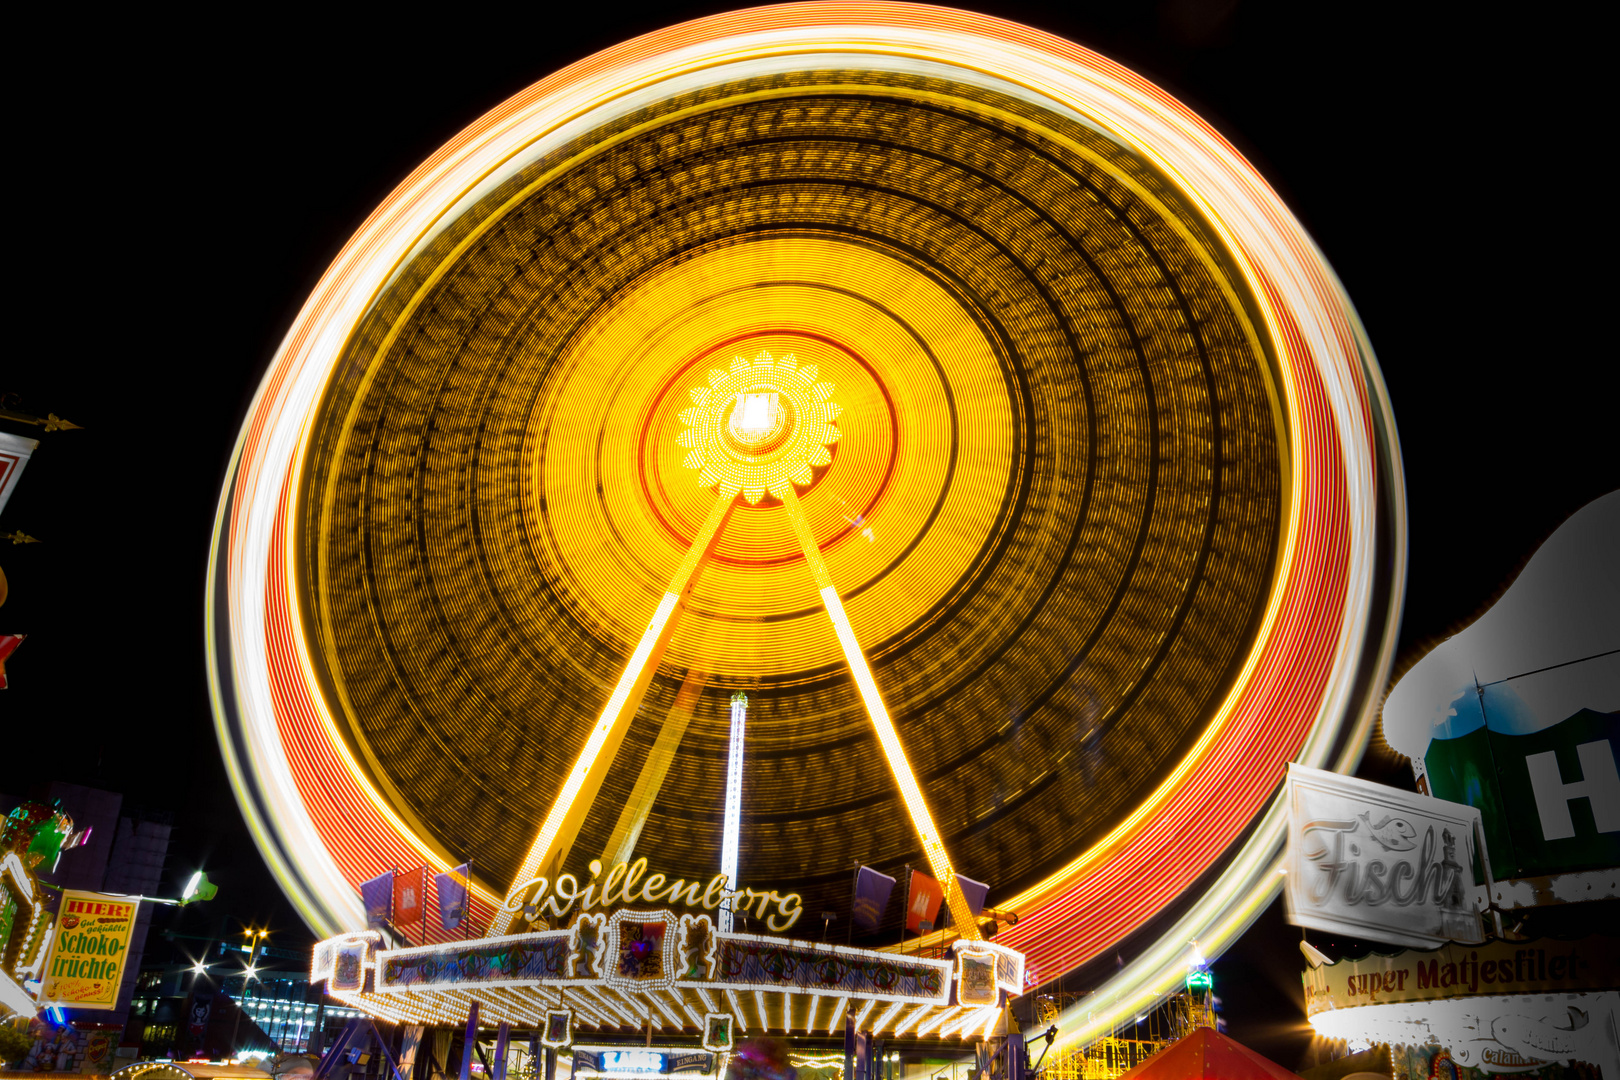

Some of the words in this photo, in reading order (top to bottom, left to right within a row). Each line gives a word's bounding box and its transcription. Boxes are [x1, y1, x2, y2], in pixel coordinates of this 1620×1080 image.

[1301, 817, 1454, 907] Fisch
[503, 857, 803, 932] Willenborg
[67, 901, 131, 917] HIER!
[86, 924, 126, 934] gekühlte
[58, 931, 125, 956] Schoko-
[51, 954, 117, 980] früchte
[1347, 967, 1409, 1001] super
[1416, 947, 1579, 993] Matjesfilet
[676, 1054, 707, 1066] EINGANG
